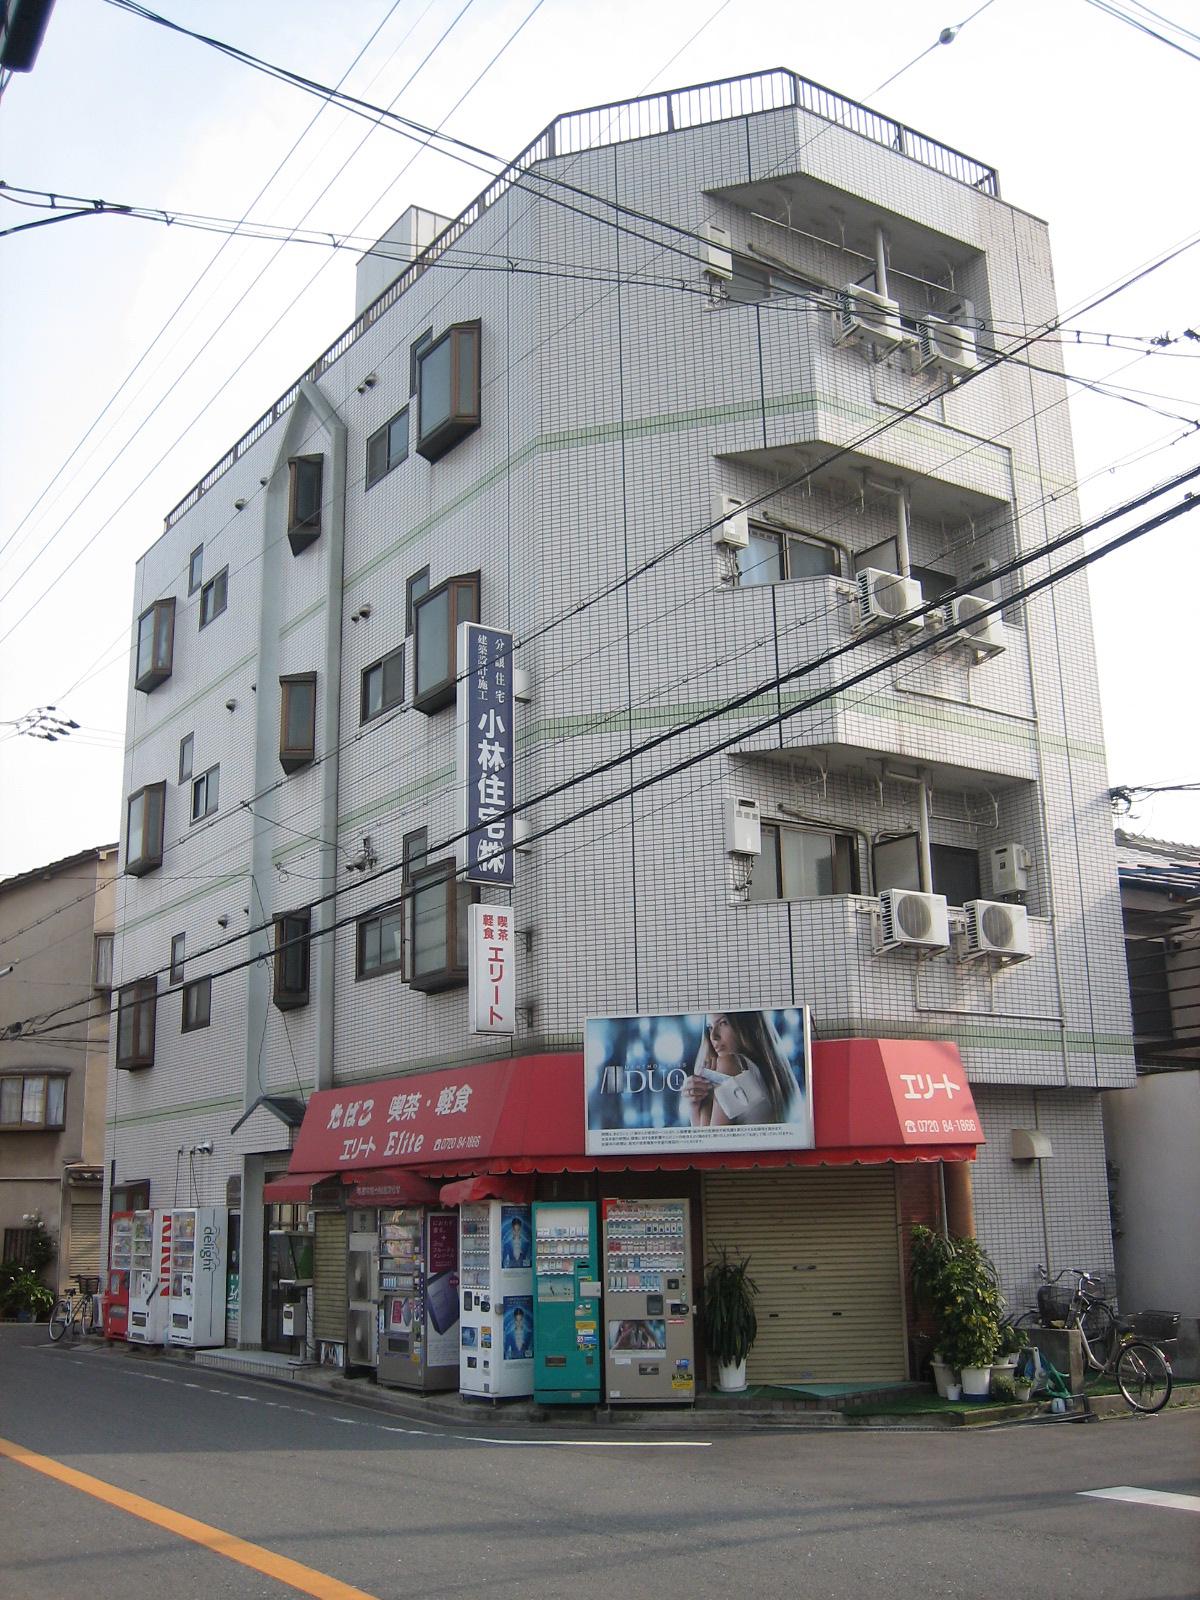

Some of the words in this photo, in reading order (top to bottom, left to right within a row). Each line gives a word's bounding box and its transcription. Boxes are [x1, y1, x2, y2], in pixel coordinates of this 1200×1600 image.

[482, 914, 495, 940] 軽食
[497, 915, 509, 942] 喫茶
[487, 946, 505, 1026] エリート
[899, 1073, 961, 1099] エリート
[327, 1099, 375, 1129] たばこ
[917, 1119, 940, 1132] 0720
[339, 1136, 376, 1161] エリート
[383, 1130, 425, 1157] Elite
[199, 1227, 214, 1271] delight
